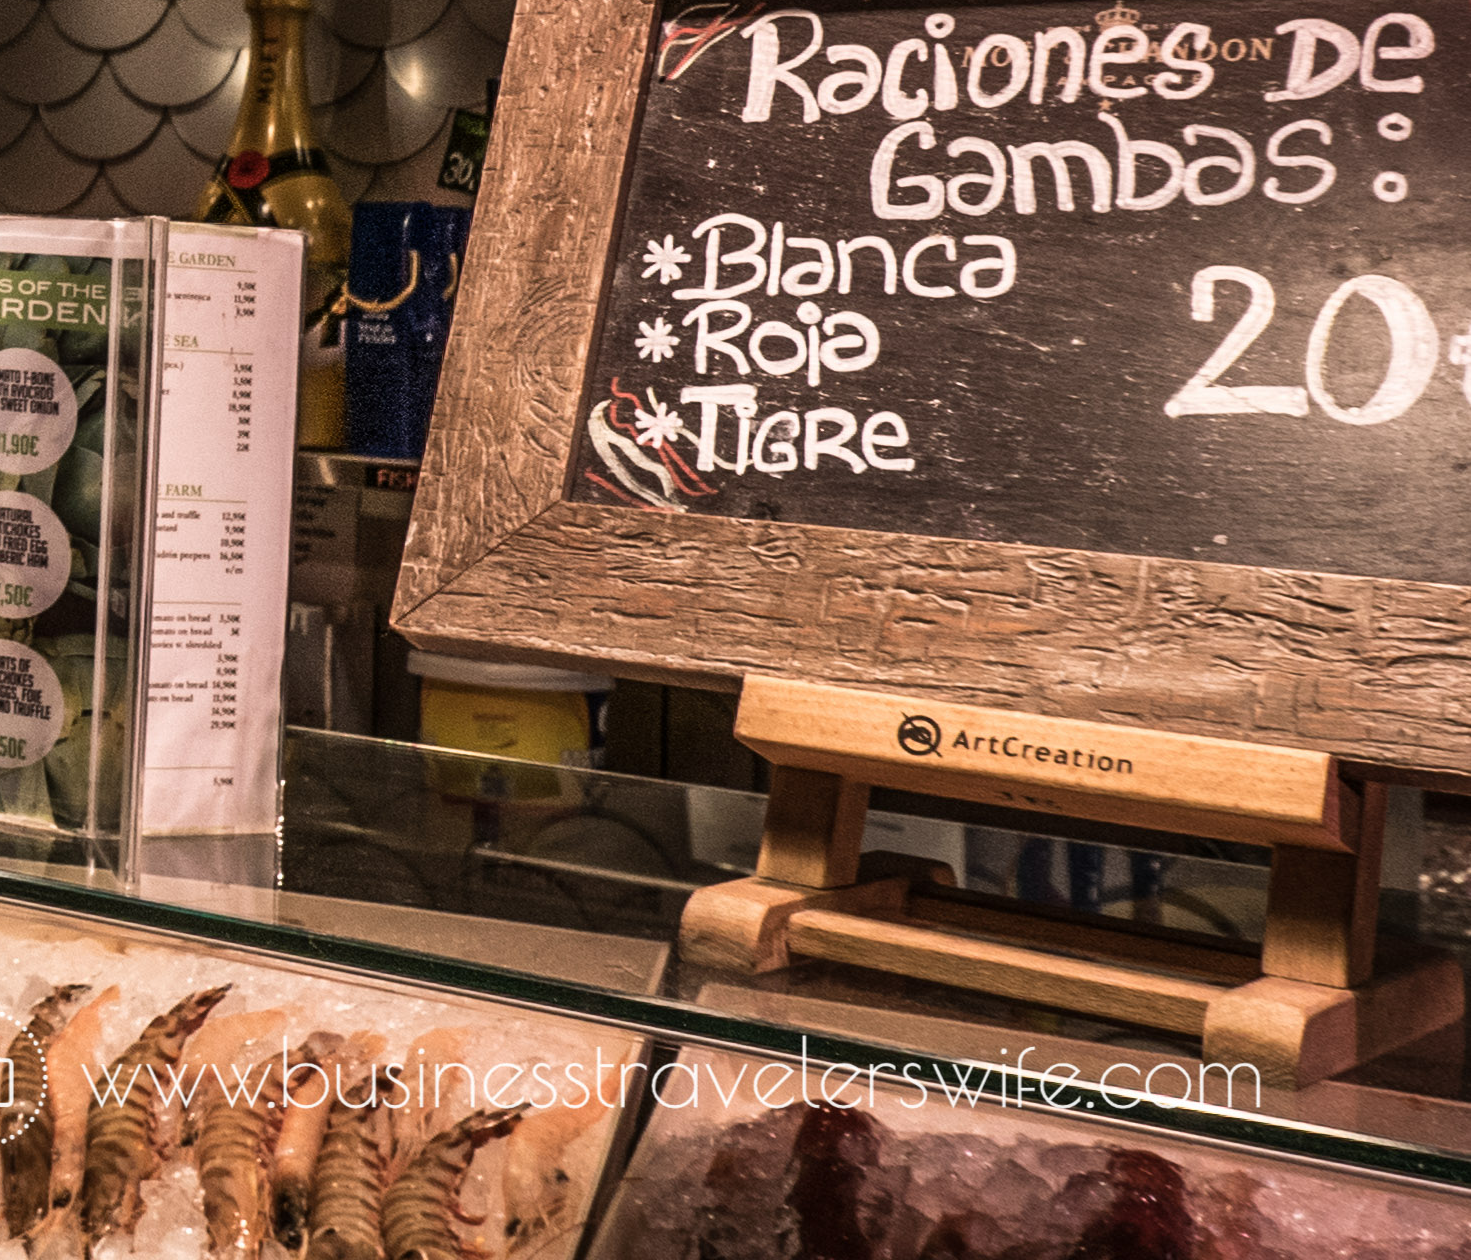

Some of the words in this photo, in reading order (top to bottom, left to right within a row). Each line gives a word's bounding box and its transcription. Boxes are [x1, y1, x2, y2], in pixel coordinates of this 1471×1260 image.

[741, 9, 1216, 124] Raciones
[178, 252, 237, 268] GARDEN
[672, 212, 1018, 300] Blanca
[17, 278, 52, 296] OF
[56, 281, 107, 300] THE
[172, 335, 200, 348] SEA
[682, 298, 881, 387] Roja
[23, 371, 56, 388] T-BONE
[11, 385, 54, 401] AVOCADO
[0, 398, 29, 414] SWEET
[30, 400, 60, 416] ONION
[165, 483, 204, 497] FARM
[2, 536, 28, 552] FRIED
[30, 540, 49, 556] EGG
[26, 554, 50, 570] HAM
[18, 657, 32, 674] OF
[12, 701, 52, 721] TRUFFLE
[951, 729, 1134, 775] ArtCreation
